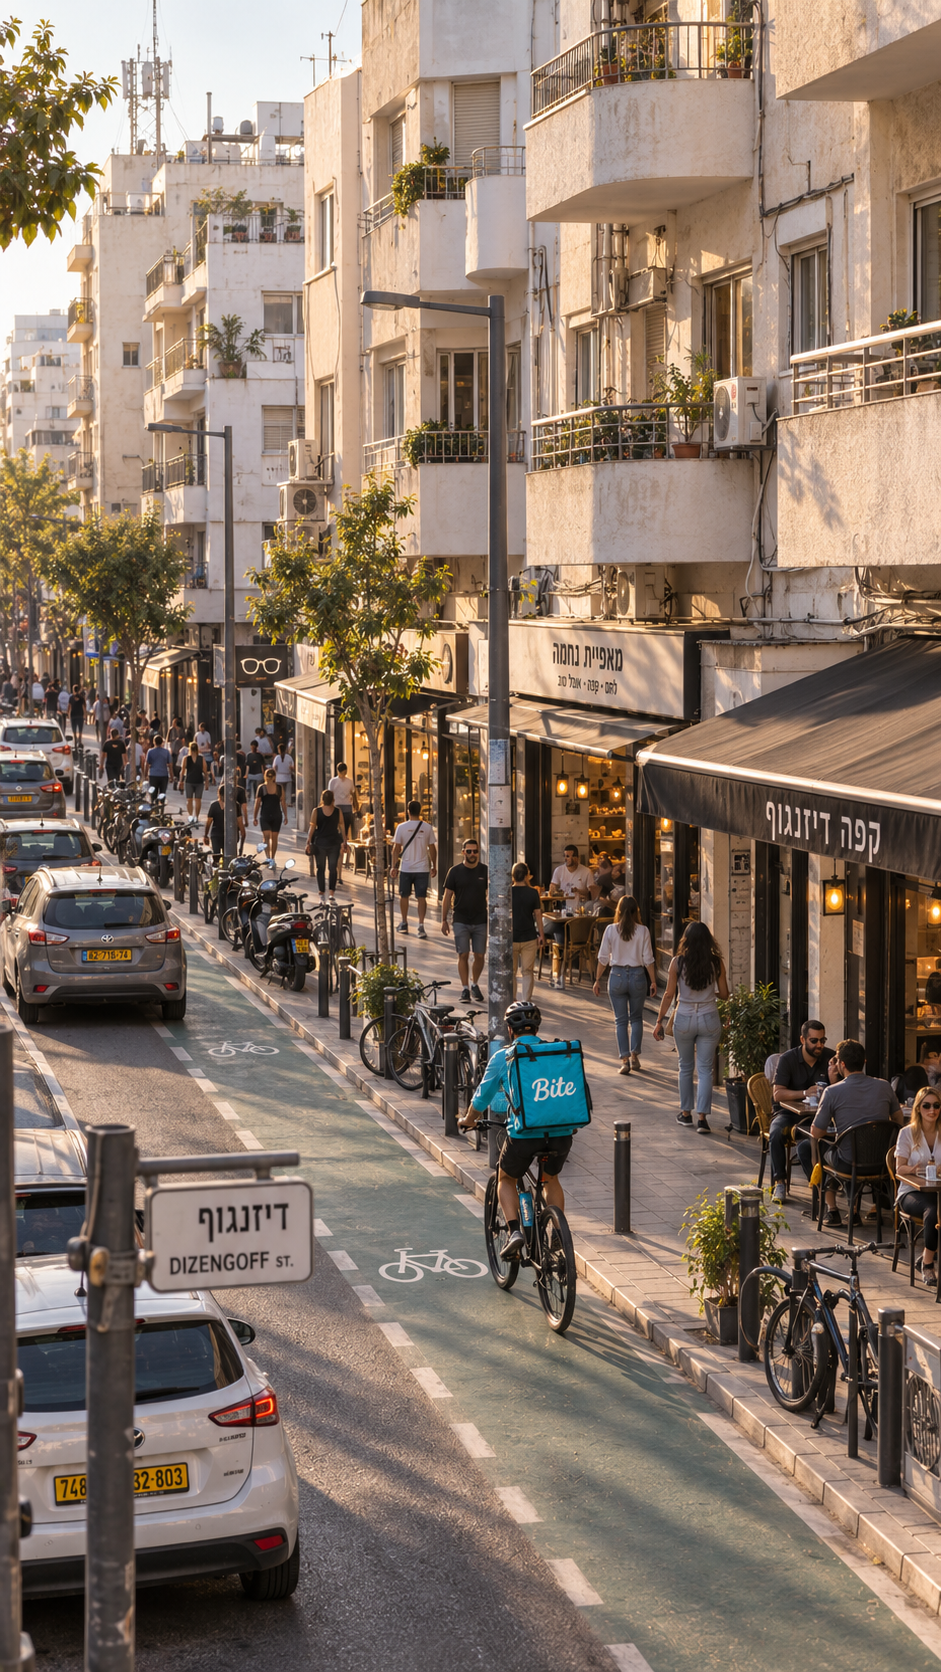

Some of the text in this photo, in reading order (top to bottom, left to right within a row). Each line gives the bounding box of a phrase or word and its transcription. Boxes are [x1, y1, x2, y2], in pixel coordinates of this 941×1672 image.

[552, 642, 623, 672] מאפיית נחמה
[766, 801, 880, 863] קפה דיזנגוף
[531, 1076, 577, 1102] Bite
[198, 1203, 289, 1243] דיזנגוף
[169, 1251, 294, 1275] DIZENGOFF ST.
